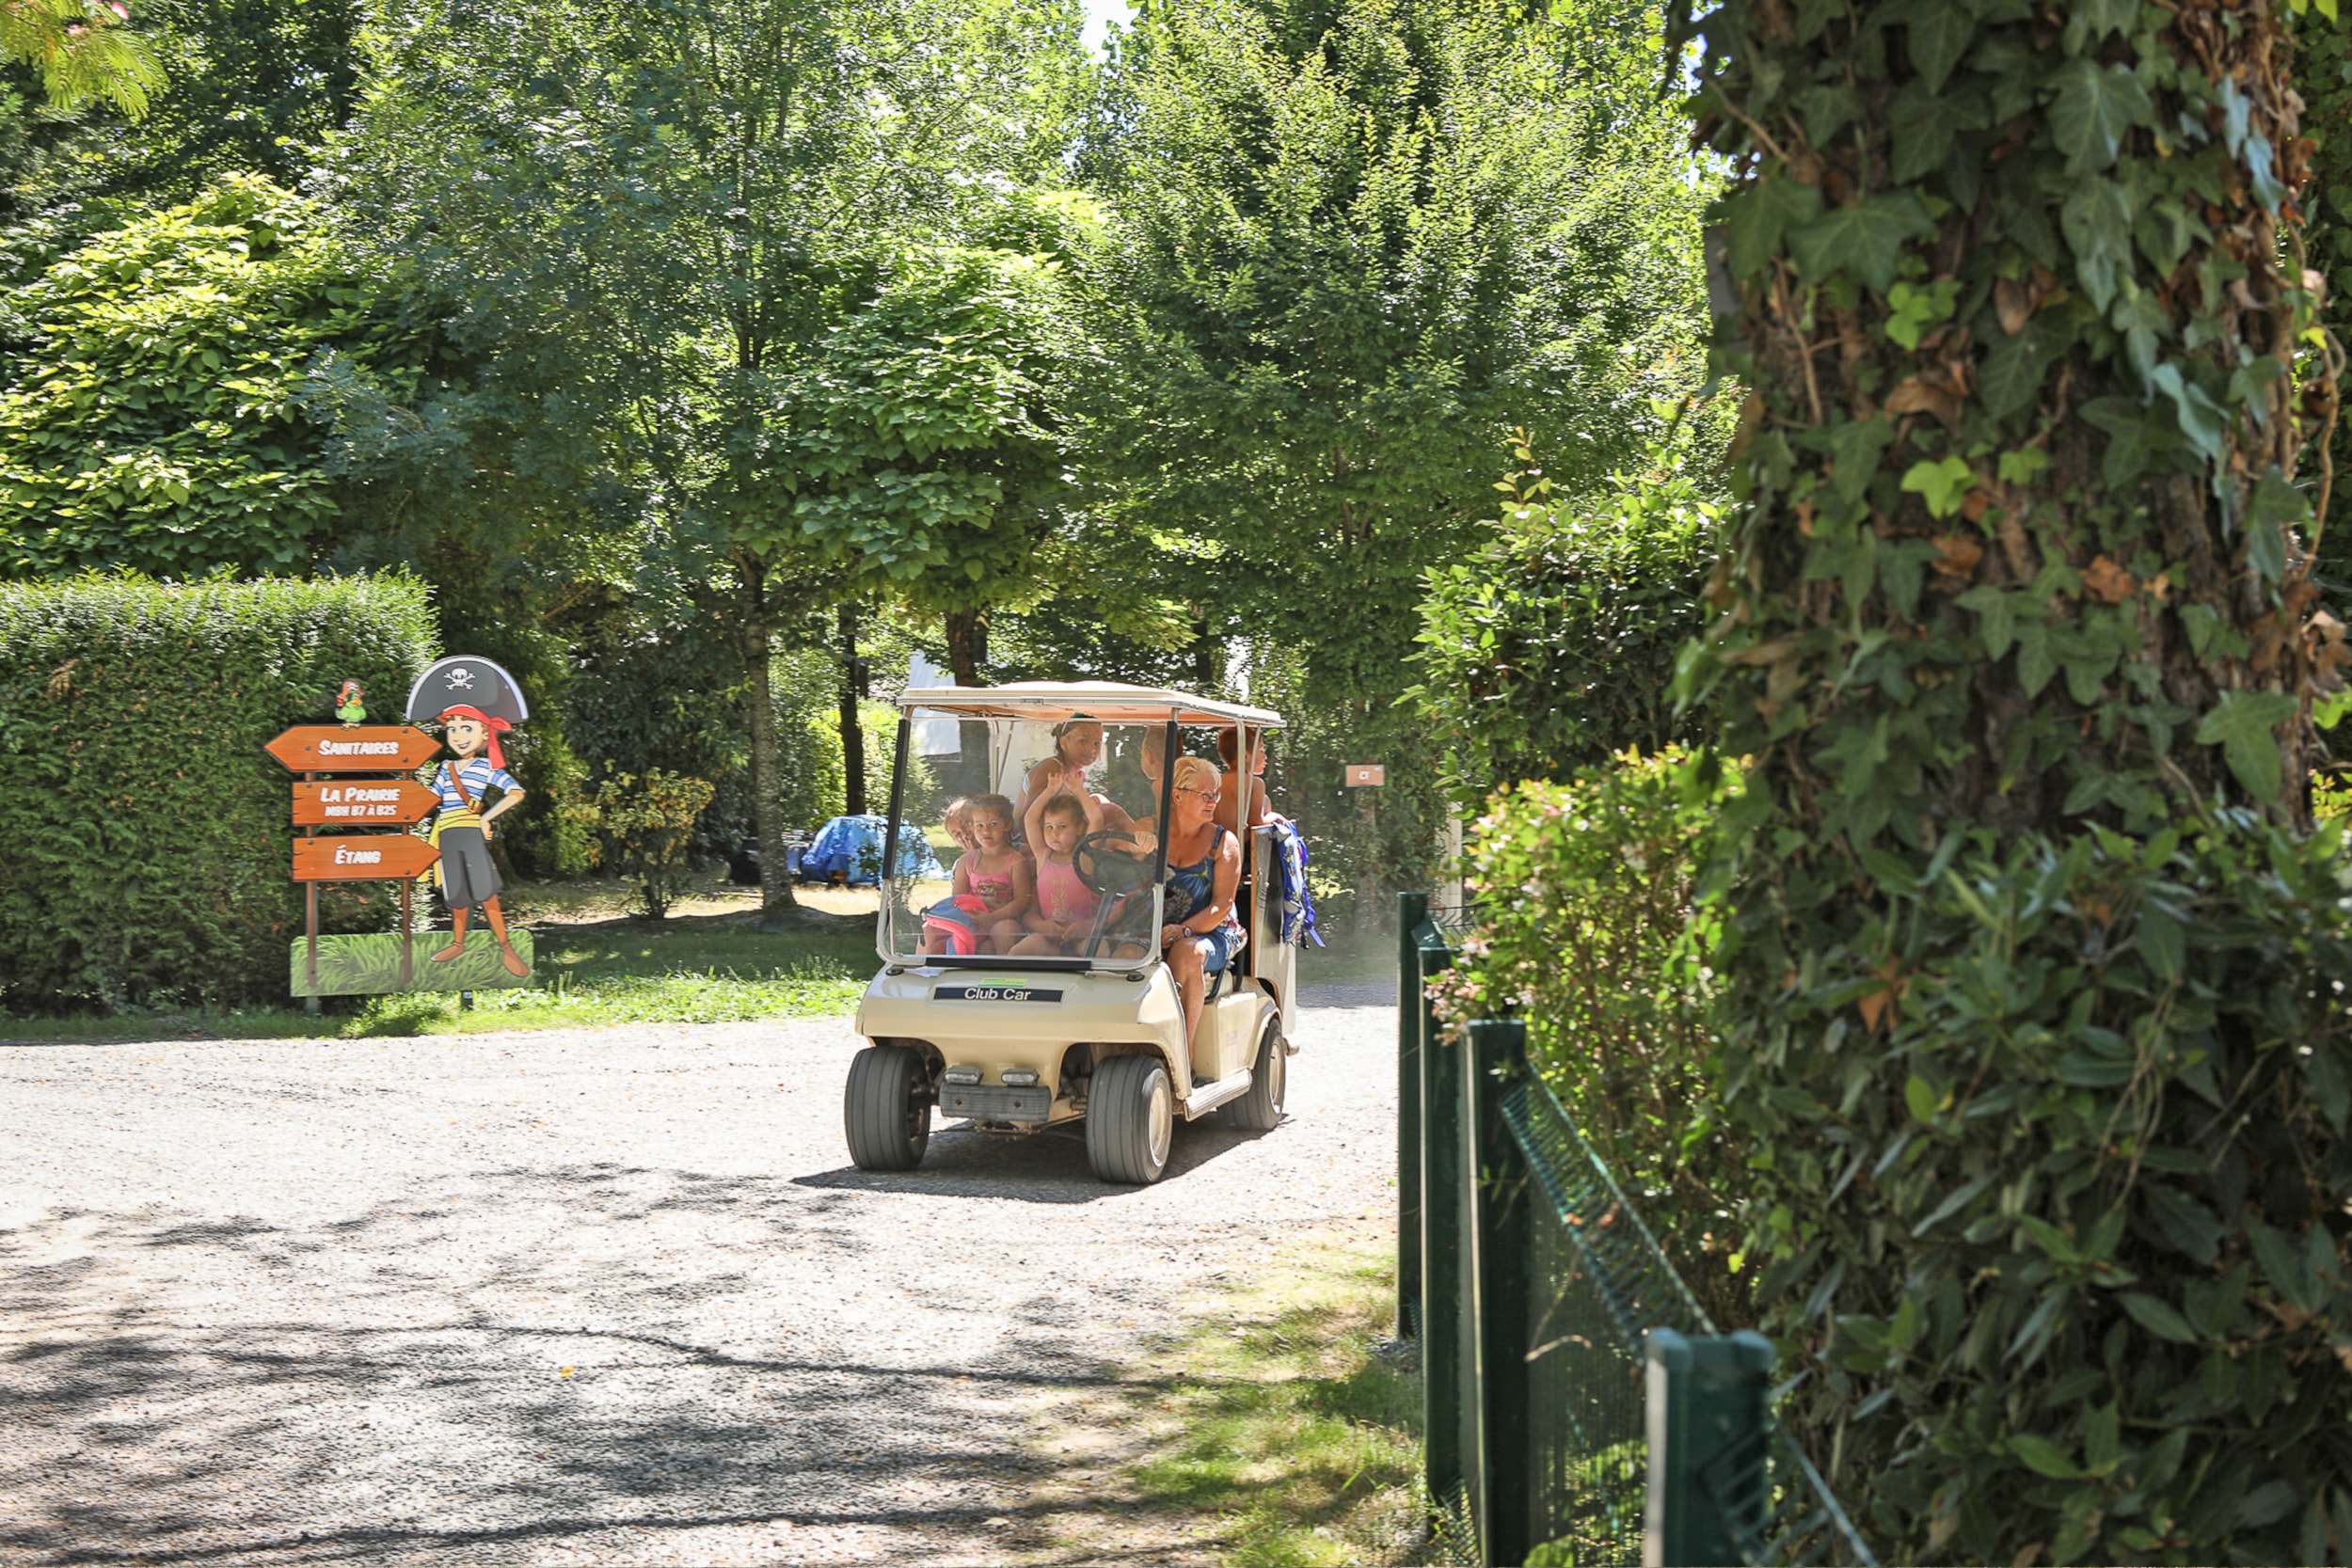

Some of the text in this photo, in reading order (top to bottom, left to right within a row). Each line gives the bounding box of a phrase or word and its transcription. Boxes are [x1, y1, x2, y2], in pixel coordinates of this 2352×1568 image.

[318, 739, 399, 755] SANITAIRES
[320, 786, 401, 802] LA PRAIRIE
[335, 844, 382, 865] ÉTANG
[964, 988, 1031, 1001] Club Car
